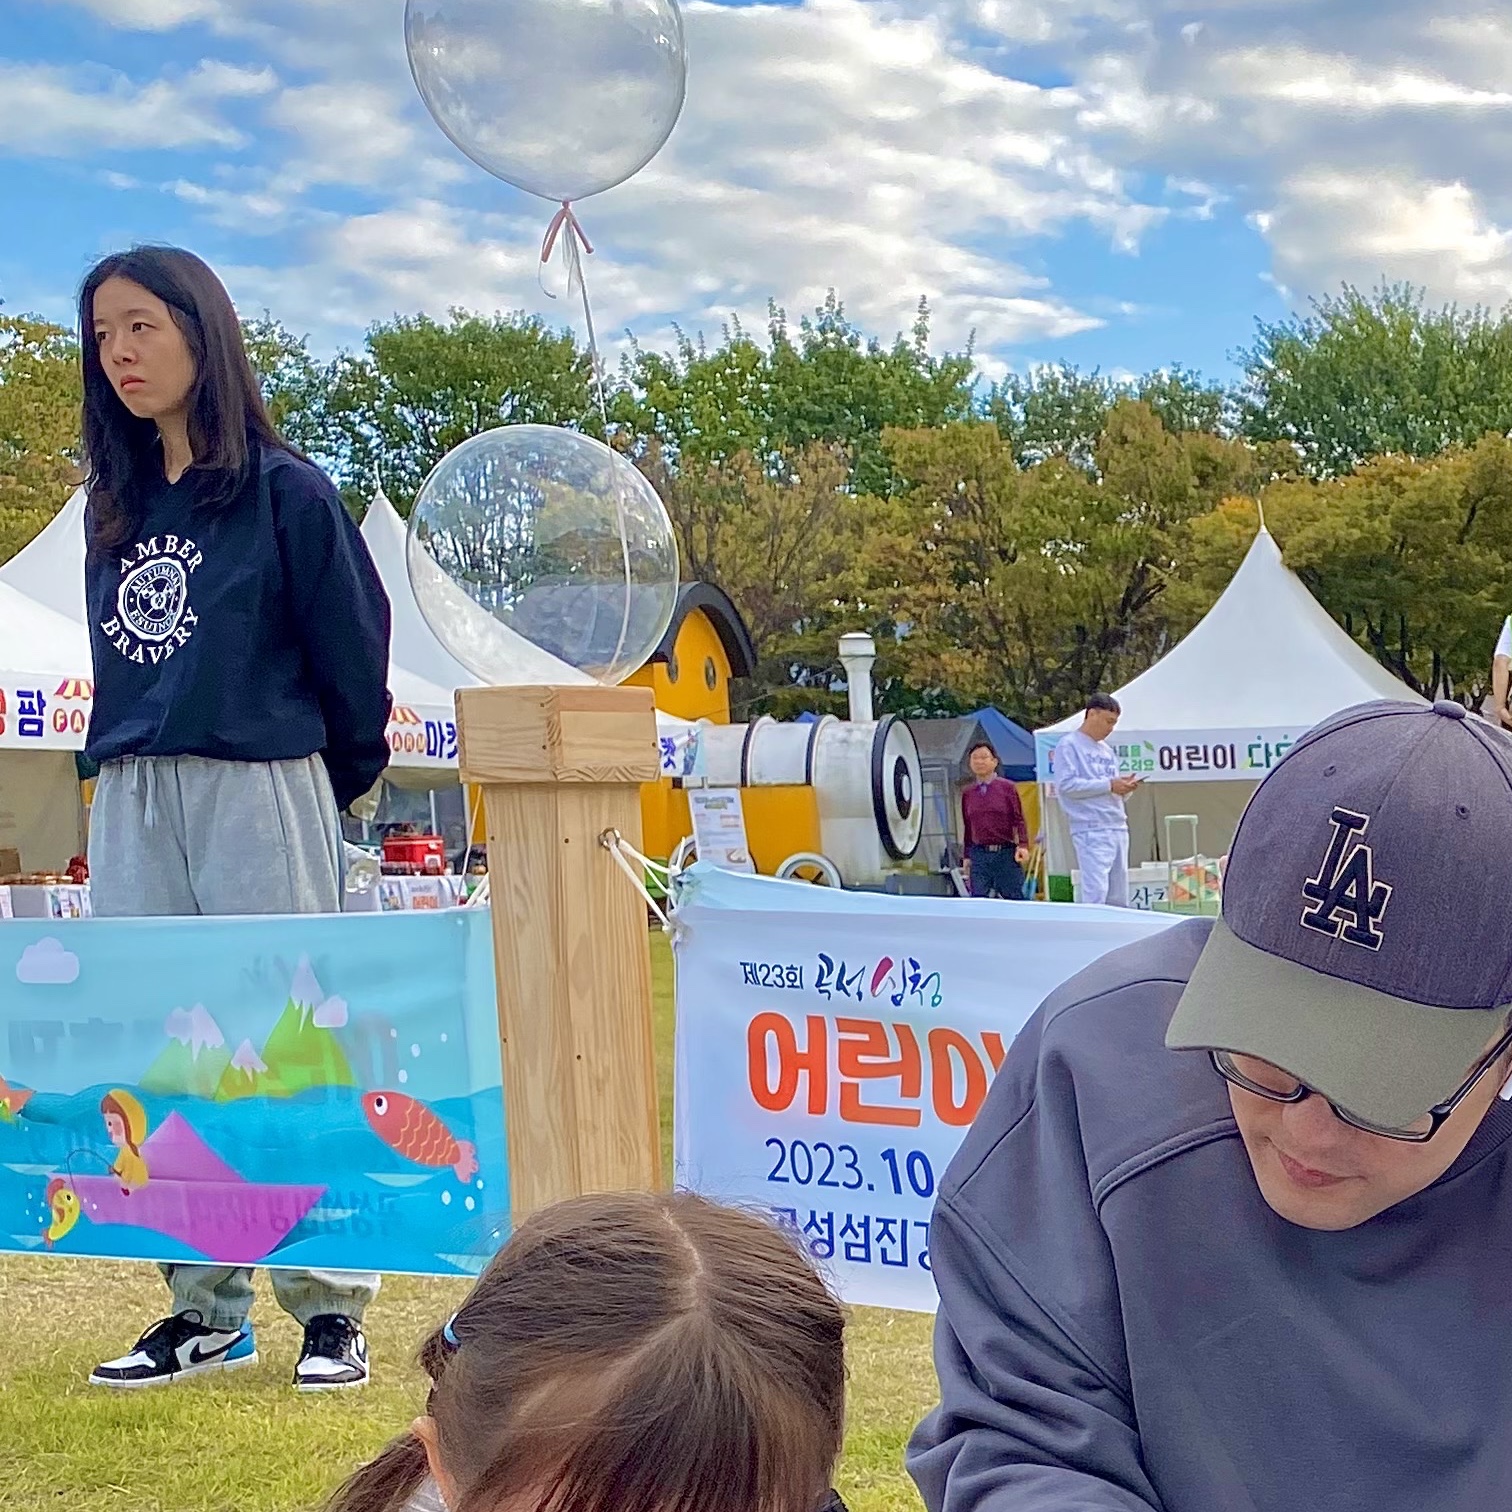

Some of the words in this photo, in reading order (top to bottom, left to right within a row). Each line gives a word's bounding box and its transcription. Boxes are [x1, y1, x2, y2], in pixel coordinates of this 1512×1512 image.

[120, 534, 203, 574] AMBER
[100, 606, 199, 664] BRAVERY
[53, 708, 93, 734] FA
[1159, 743, 1236, 771] 어린이
[1301, 806, 1392, 951] LA
[739, 961, 804, 990] 제23회
